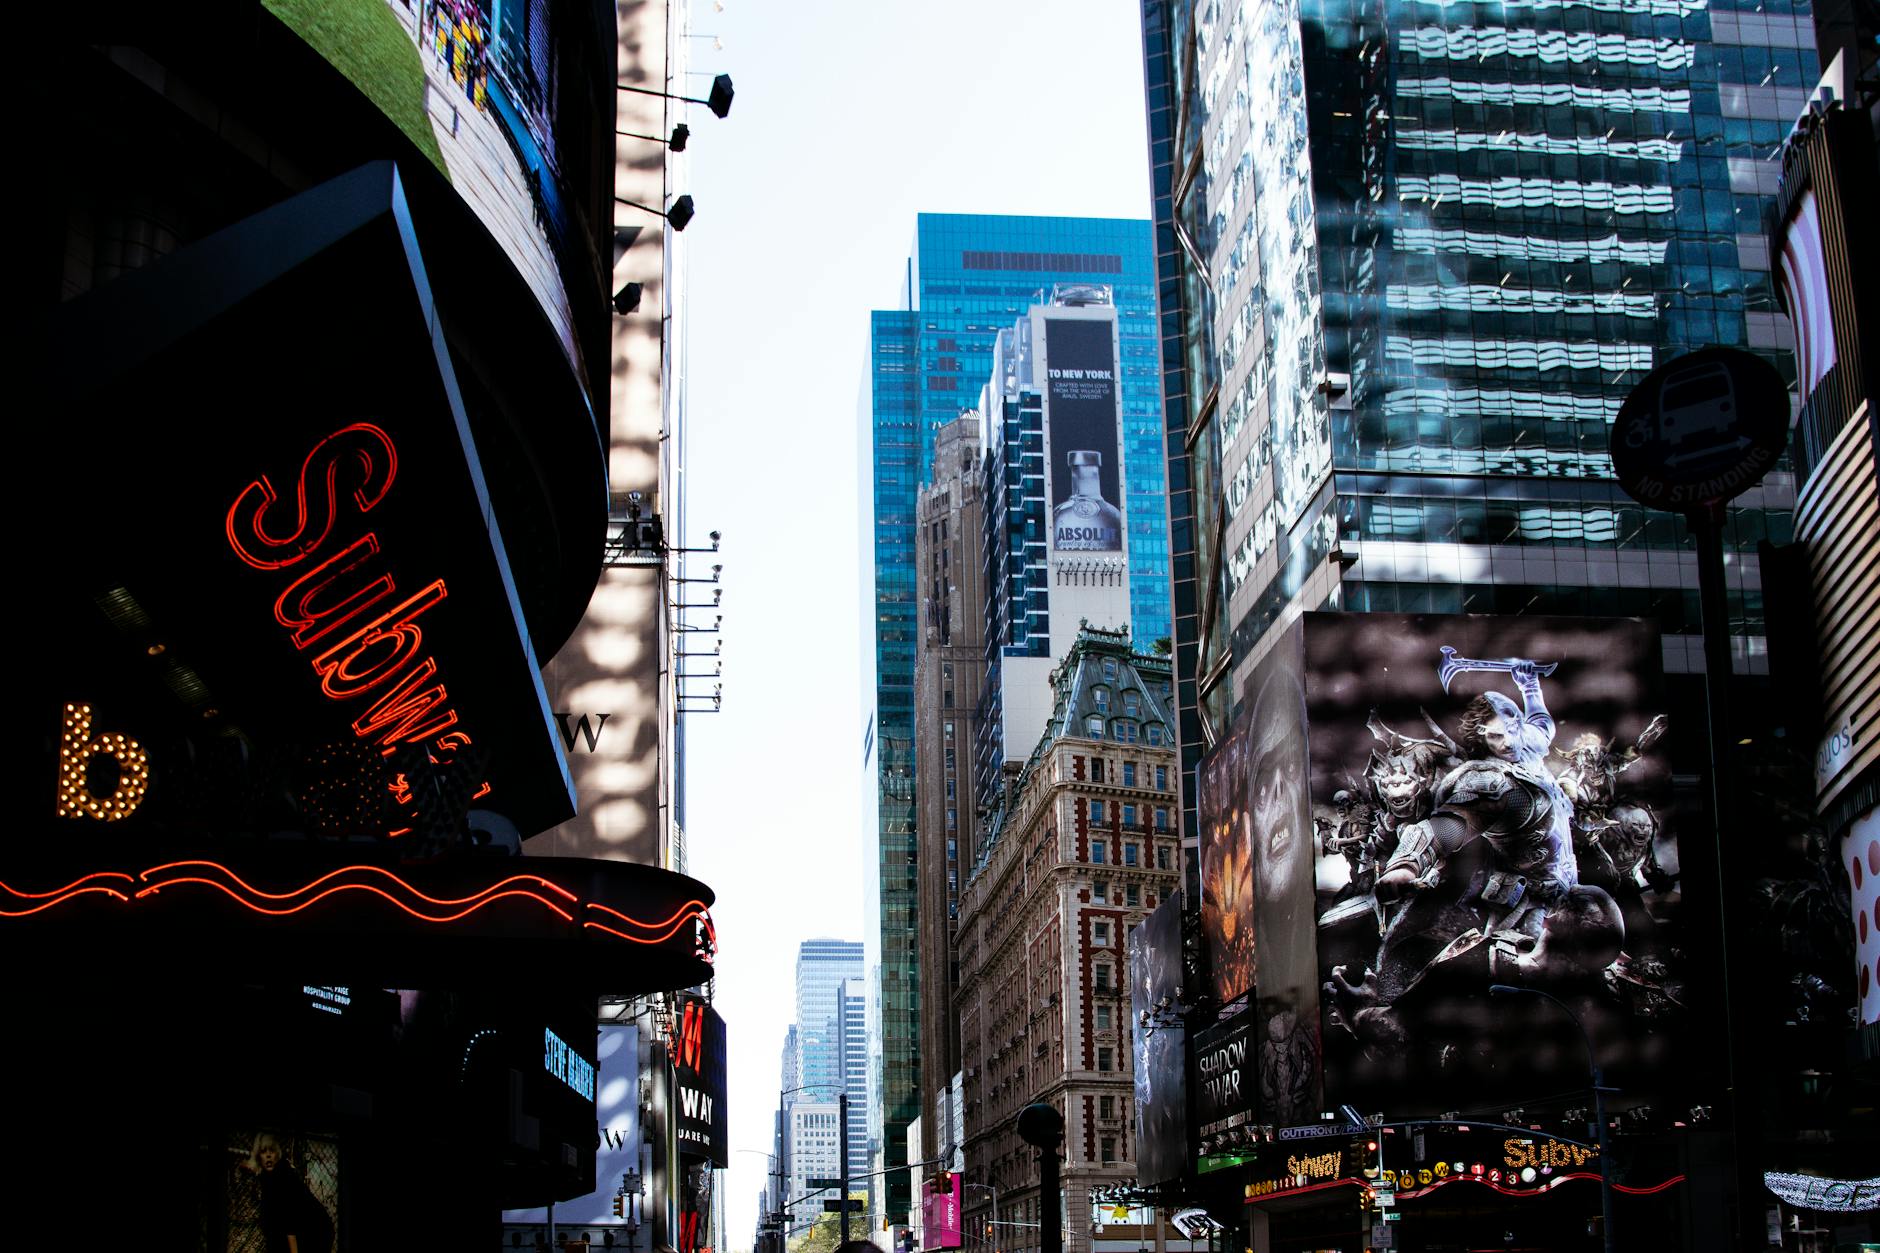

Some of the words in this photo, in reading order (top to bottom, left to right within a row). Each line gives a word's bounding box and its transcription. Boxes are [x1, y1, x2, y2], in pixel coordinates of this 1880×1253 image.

[1048, 369, 1061, 379] TO
[1062, 369, 1083, 379] NEW
[1633, 474, 1664, 500] NO
[1668, 446, 1774, 504] STANDING
[544, 1026, 568, 1084] STEVE
[1200, 1037, 1247, 1080] SHADOW
[1209, 1069, 1243, 1107] WAR
[1287, 1150, 1343, 1181] Subway
